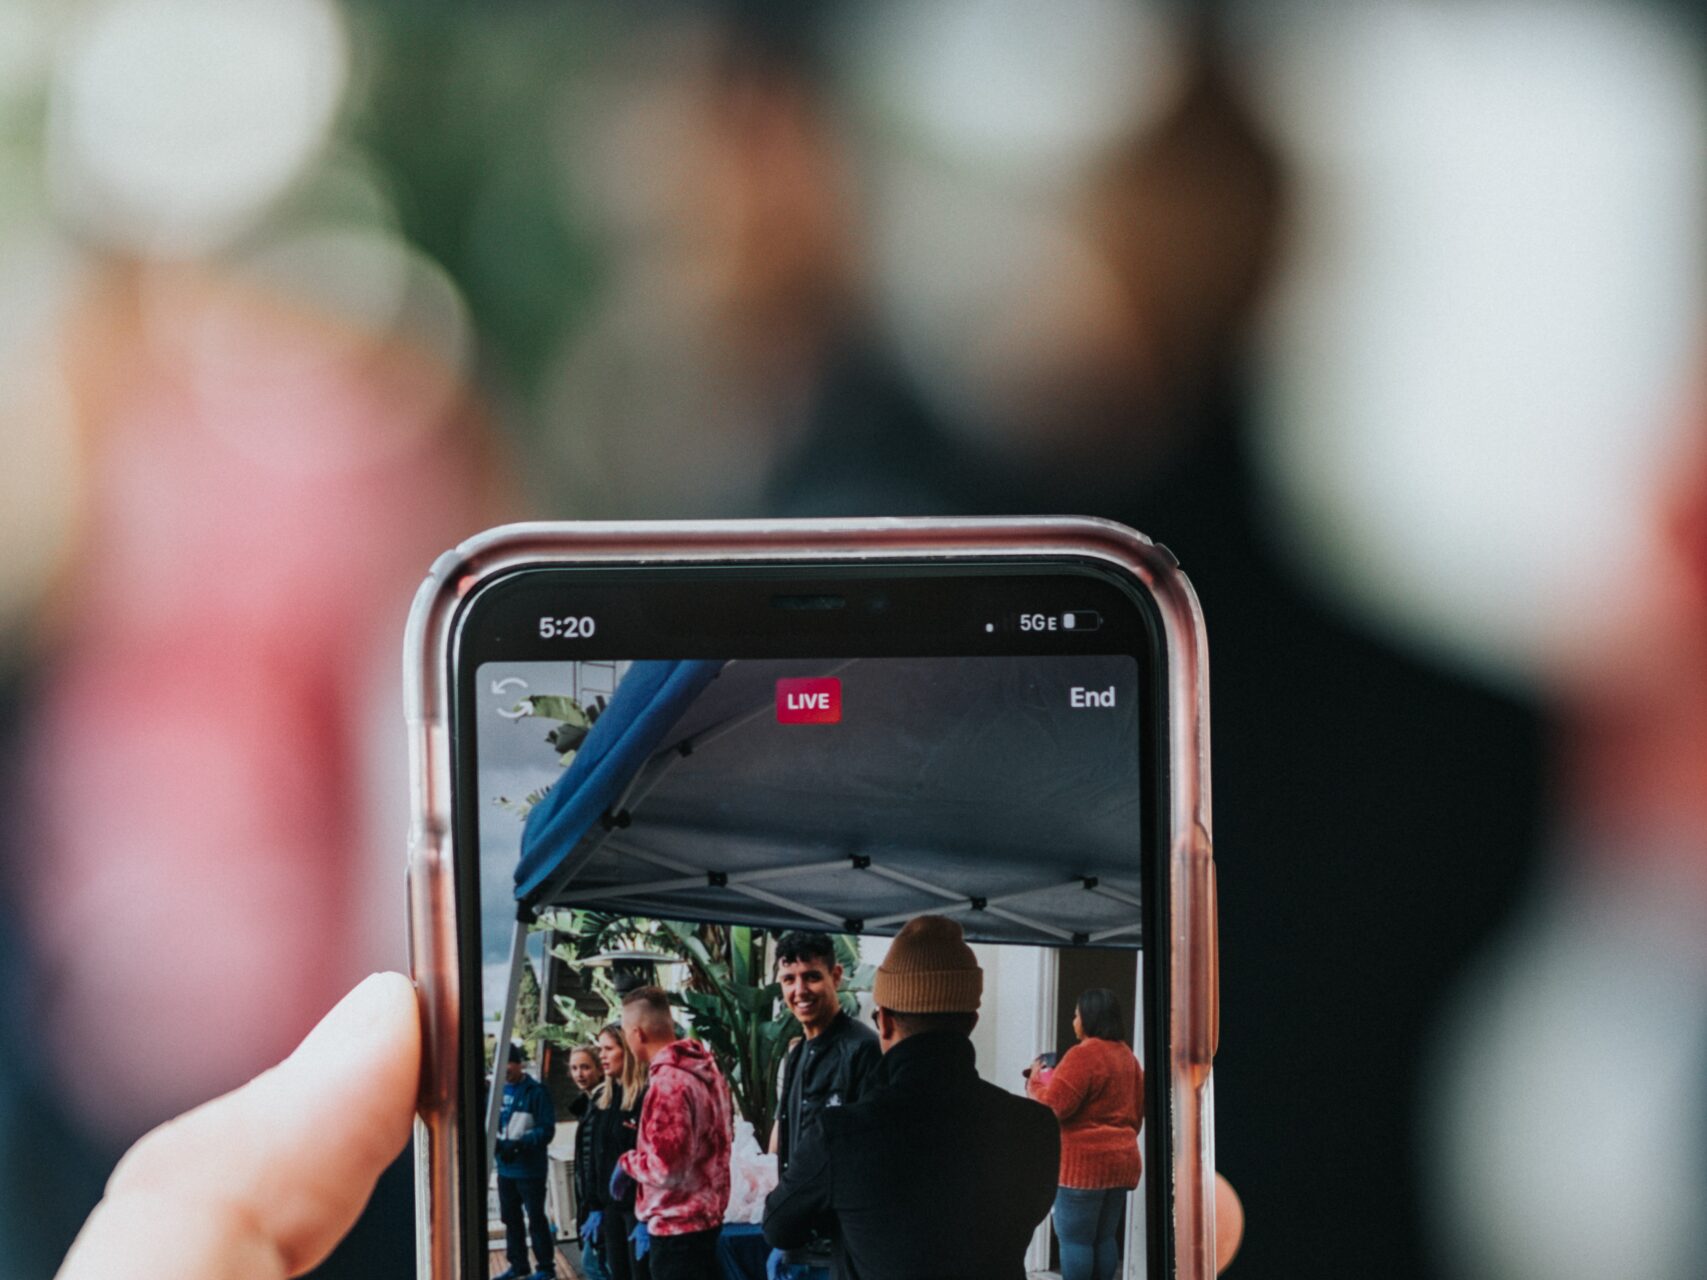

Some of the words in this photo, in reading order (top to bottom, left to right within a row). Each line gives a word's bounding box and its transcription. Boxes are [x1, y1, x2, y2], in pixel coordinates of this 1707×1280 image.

[538, 616, 596, 639] 5:20
[787, 692, 830, 711] LIVE
[1070, 685, 1116, 708] End
